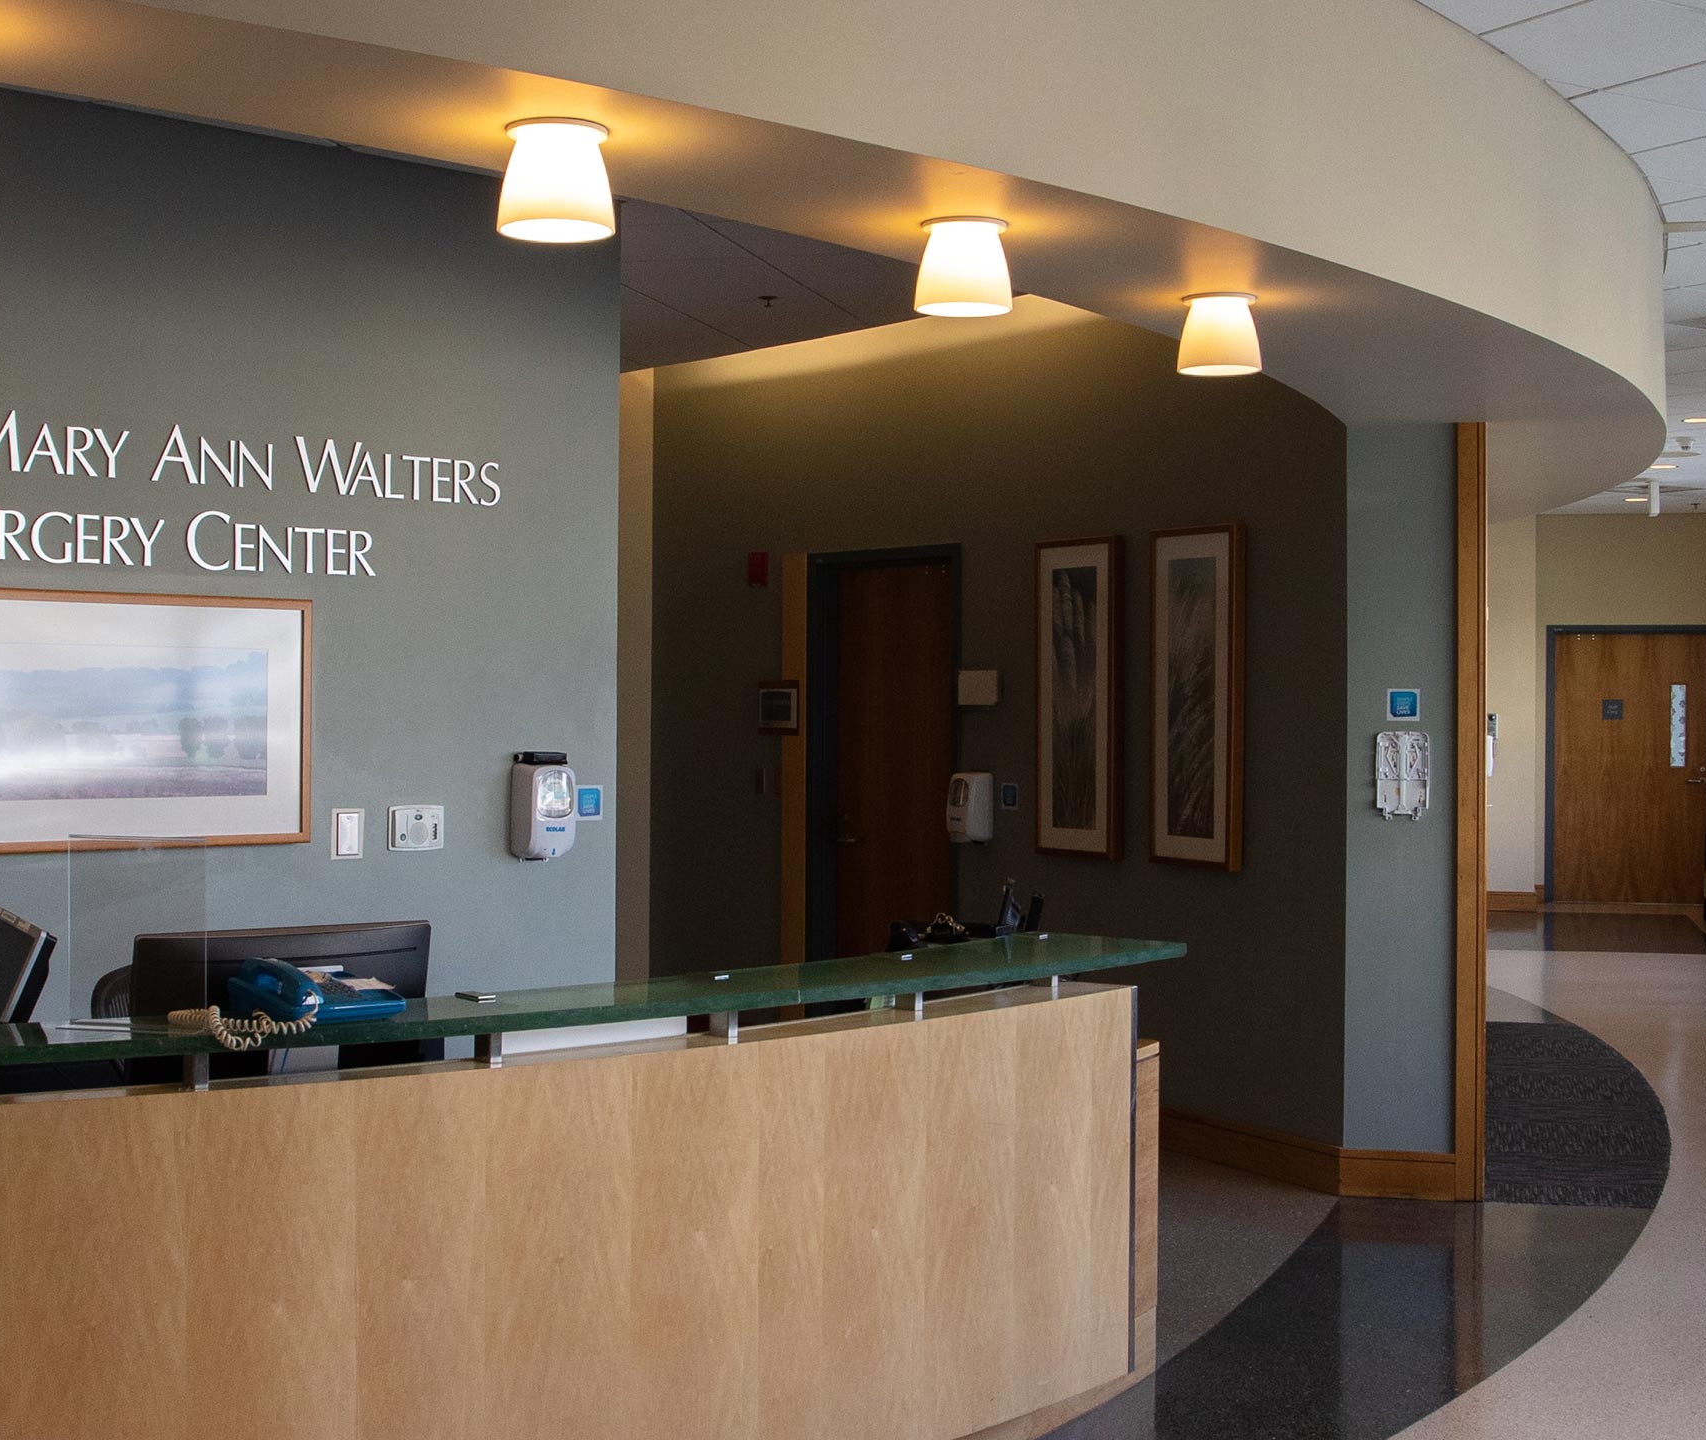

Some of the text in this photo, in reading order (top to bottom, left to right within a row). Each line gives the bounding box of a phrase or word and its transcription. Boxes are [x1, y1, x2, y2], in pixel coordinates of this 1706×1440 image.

[150, 424, 274, 491] ANN
[294, 436, 501, 507] WALTERS
[186, 510, 376, 576] CENTER
